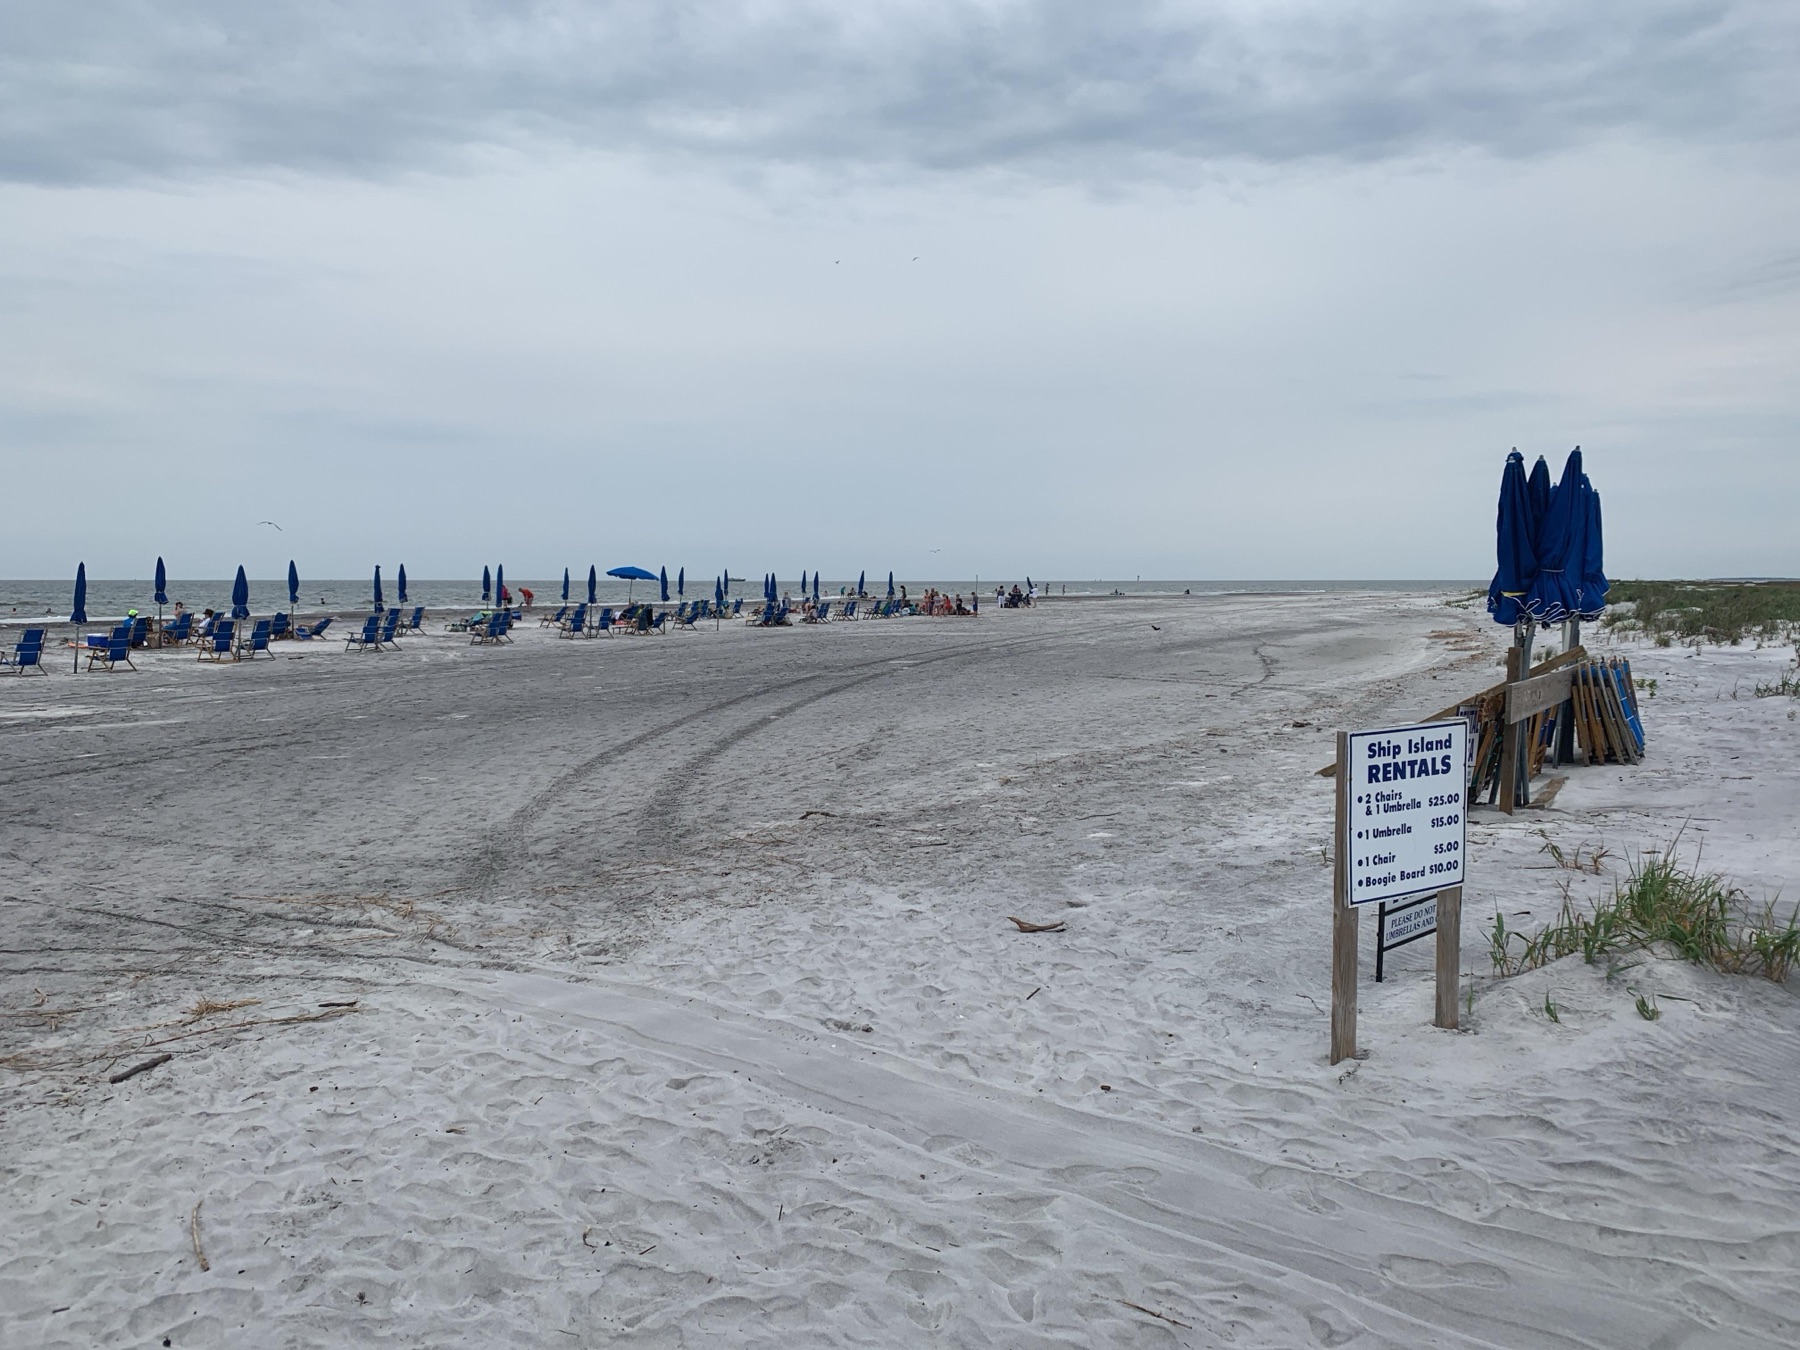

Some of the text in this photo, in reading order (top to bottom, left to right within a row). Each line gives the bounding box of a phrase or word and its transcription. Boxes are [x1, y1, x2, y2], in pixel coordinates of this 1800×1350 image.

[1368, 740, 1401, 759] Ship
[1408, 734, 1452, 754] Island
[1368, 755, 1452, 784] RENTALS
[1365, 793, 1459, 816] & 1 Umbrella $25.00
[1366, 790, 1402, 804] 2 Chairs
[1366, 814, 1459, 839] 1 Umbrella $15.00
[1366, 841, 1459, 866] 1 Chair $5.00
[1366, 860, 1458, 887] Boogie Board $10.00
[1391, 913, 1413, 928] PLEASE
[1414, 910, 1423, 920] DO
[1424, 904, 1436, 916] NOT
[1386, 917, 1434, 941] UMBRELLAS AND
